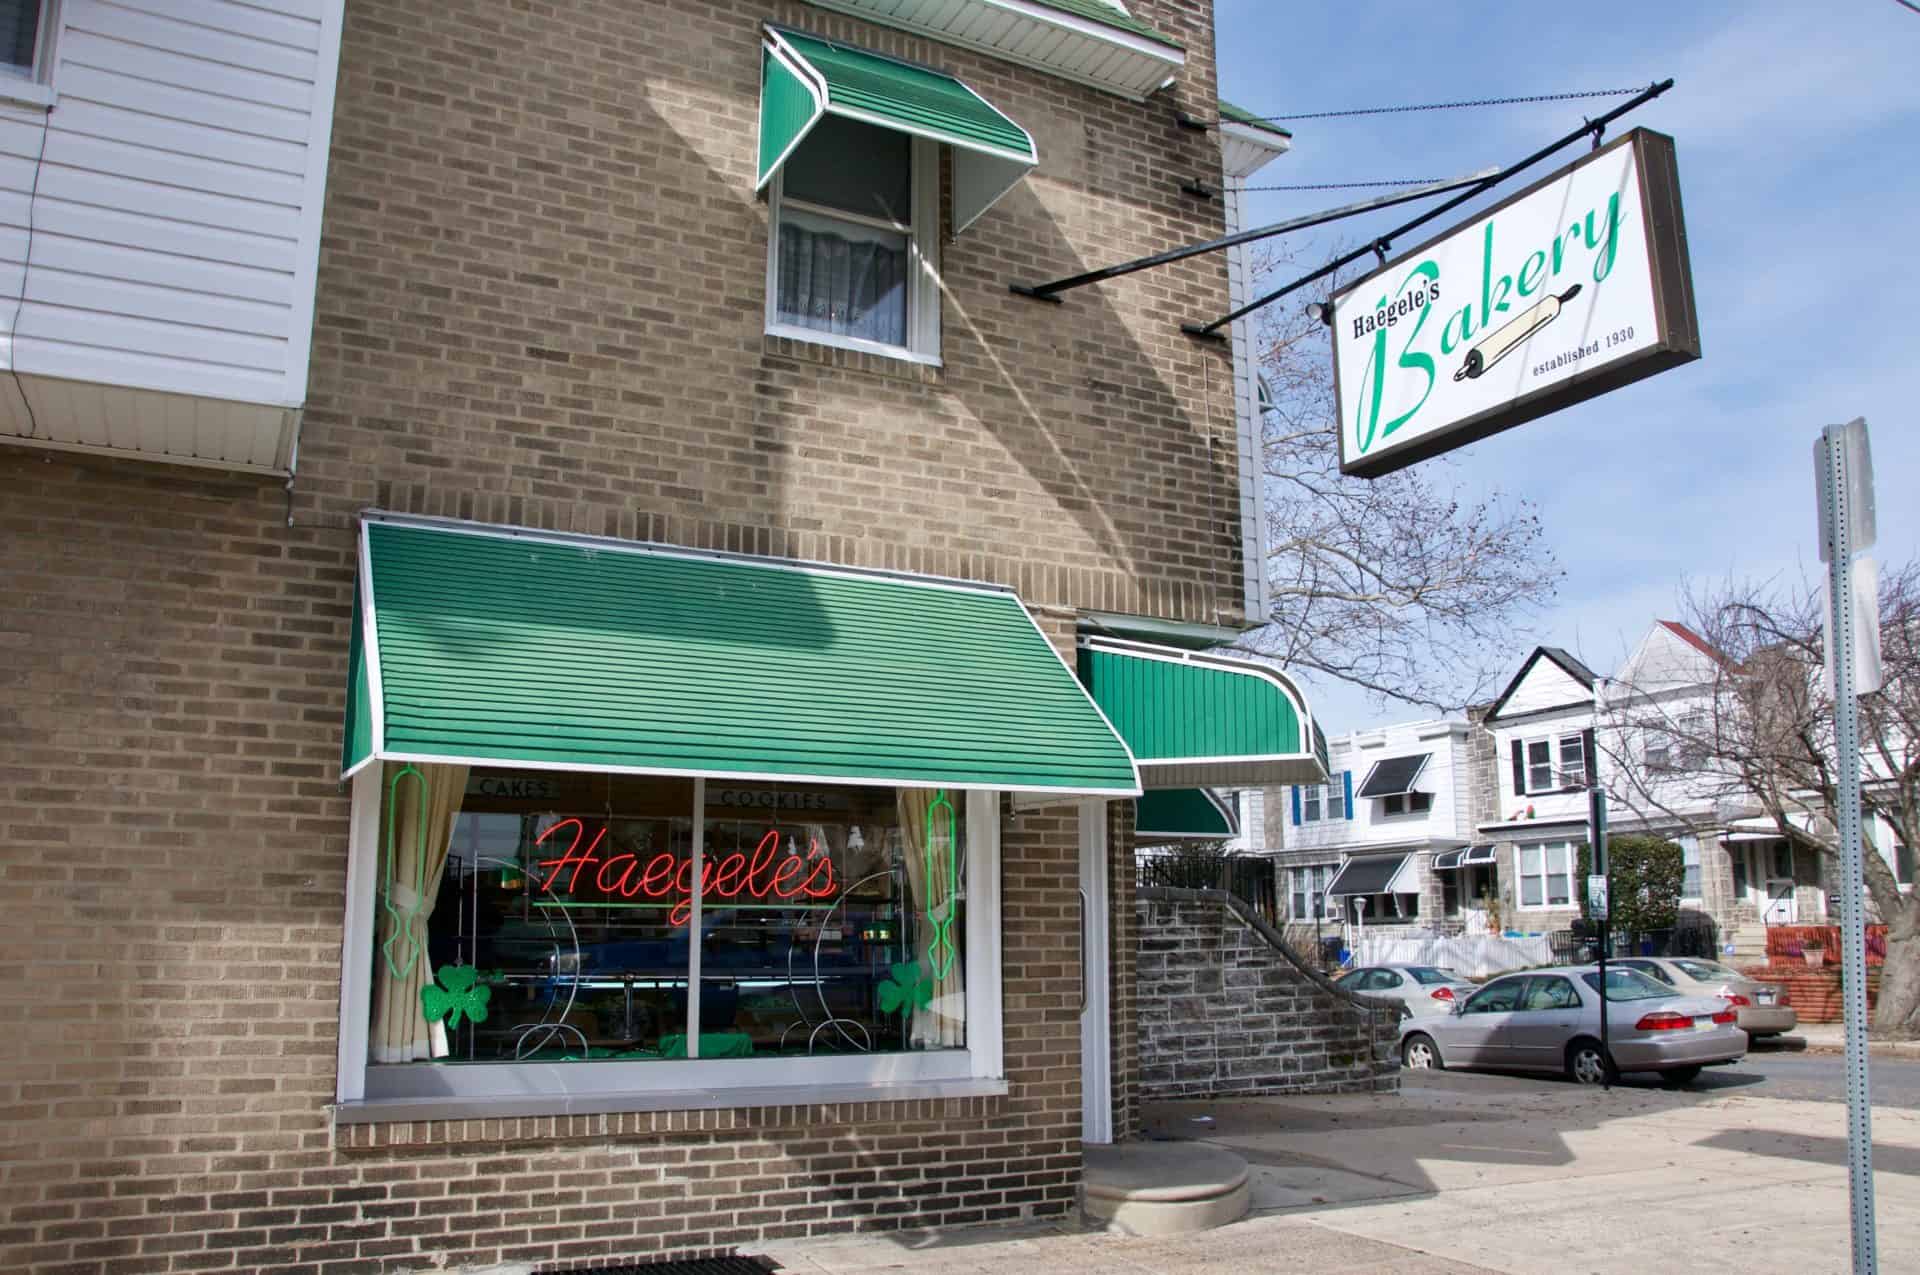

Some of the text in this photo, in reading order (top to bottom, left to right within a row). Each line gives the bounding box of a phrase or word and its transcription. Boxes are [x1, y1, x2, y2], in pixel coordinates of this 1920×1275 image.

[1353, 280, 1440, 339] Haegele's
[1357, 191, 1627, 455] Bakery
[1533, 326, 1634, 376] established 1930
[721, 790, 826, 810] COOKIES
[536, 818, 836, 926] Haegele's
